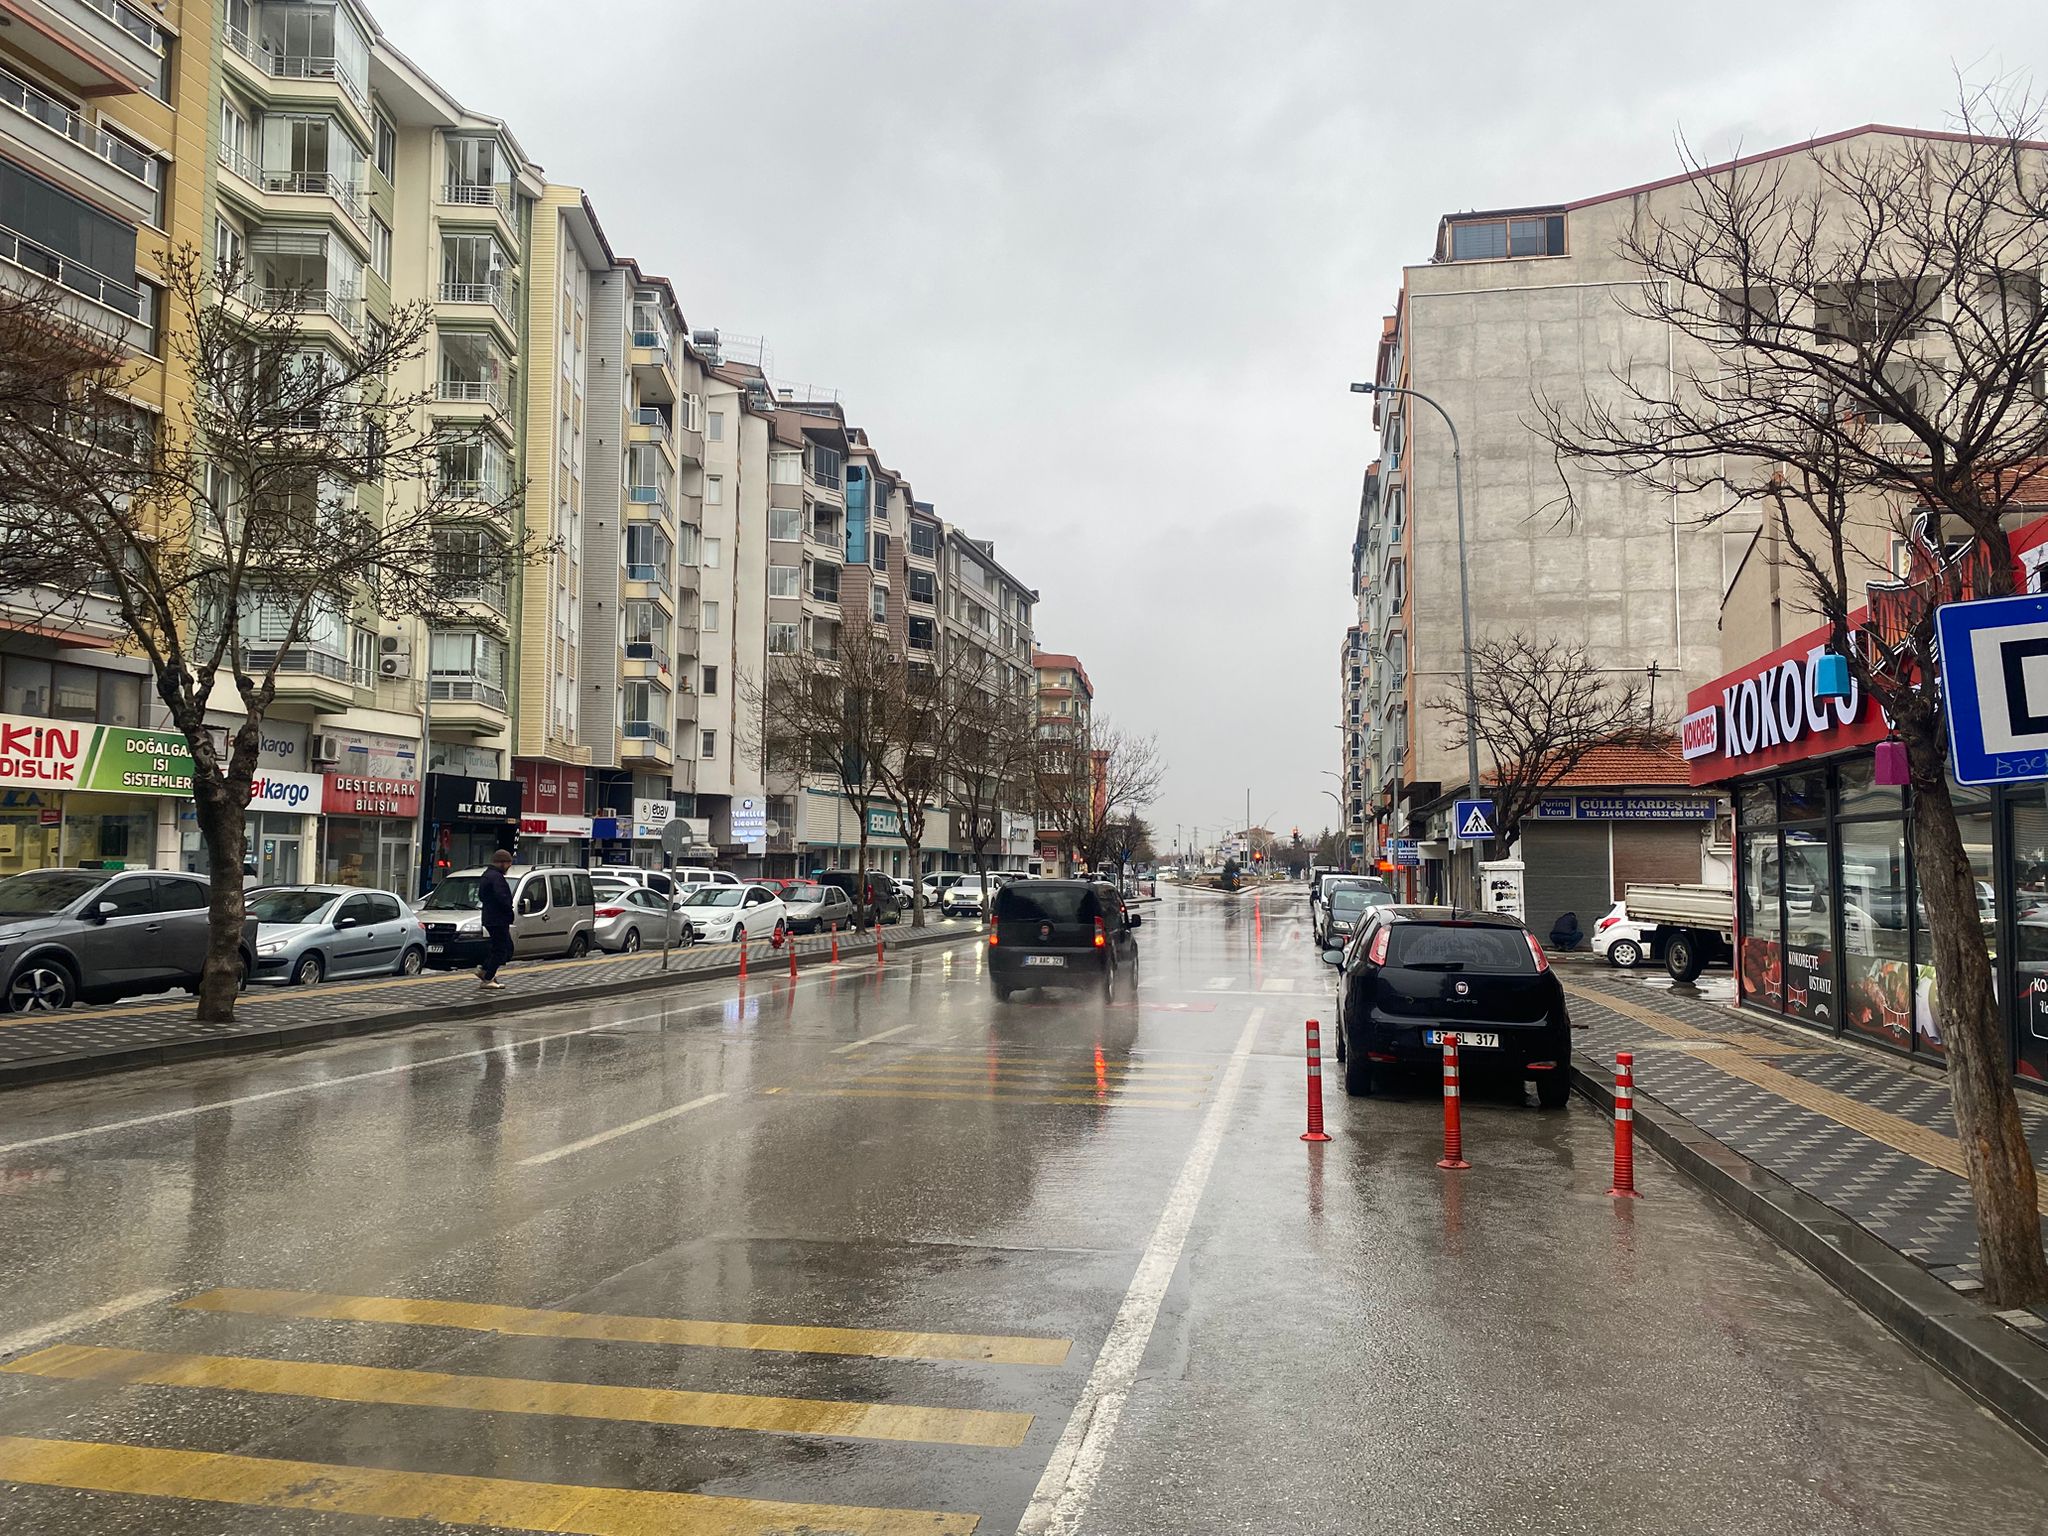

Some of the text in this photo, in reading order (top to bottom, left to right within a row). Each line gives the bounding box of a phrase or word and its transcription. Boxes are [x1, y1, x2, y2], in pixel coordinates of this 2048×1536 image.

[1683, 715, 1715, 750] KOKOREÇ
[126, 737, 192, 758] DOĞALGA
[153, 758, 169, 771] ISI
[337, 778, 416, 796] DESTEKPARK
[539, 783, 557, 794] OLUR
[356, 796, 398, 815] BİLİŞİM
[458, 803, 507, 815] MY DESIGN
[651, 803, 669, 818] ebay
[1540, 800, 1570, 808] Purina
[1580, 798, 1710, 811] GÜLLE KARDEŞLER
[1476, 1034, 1495, 1046] 317
